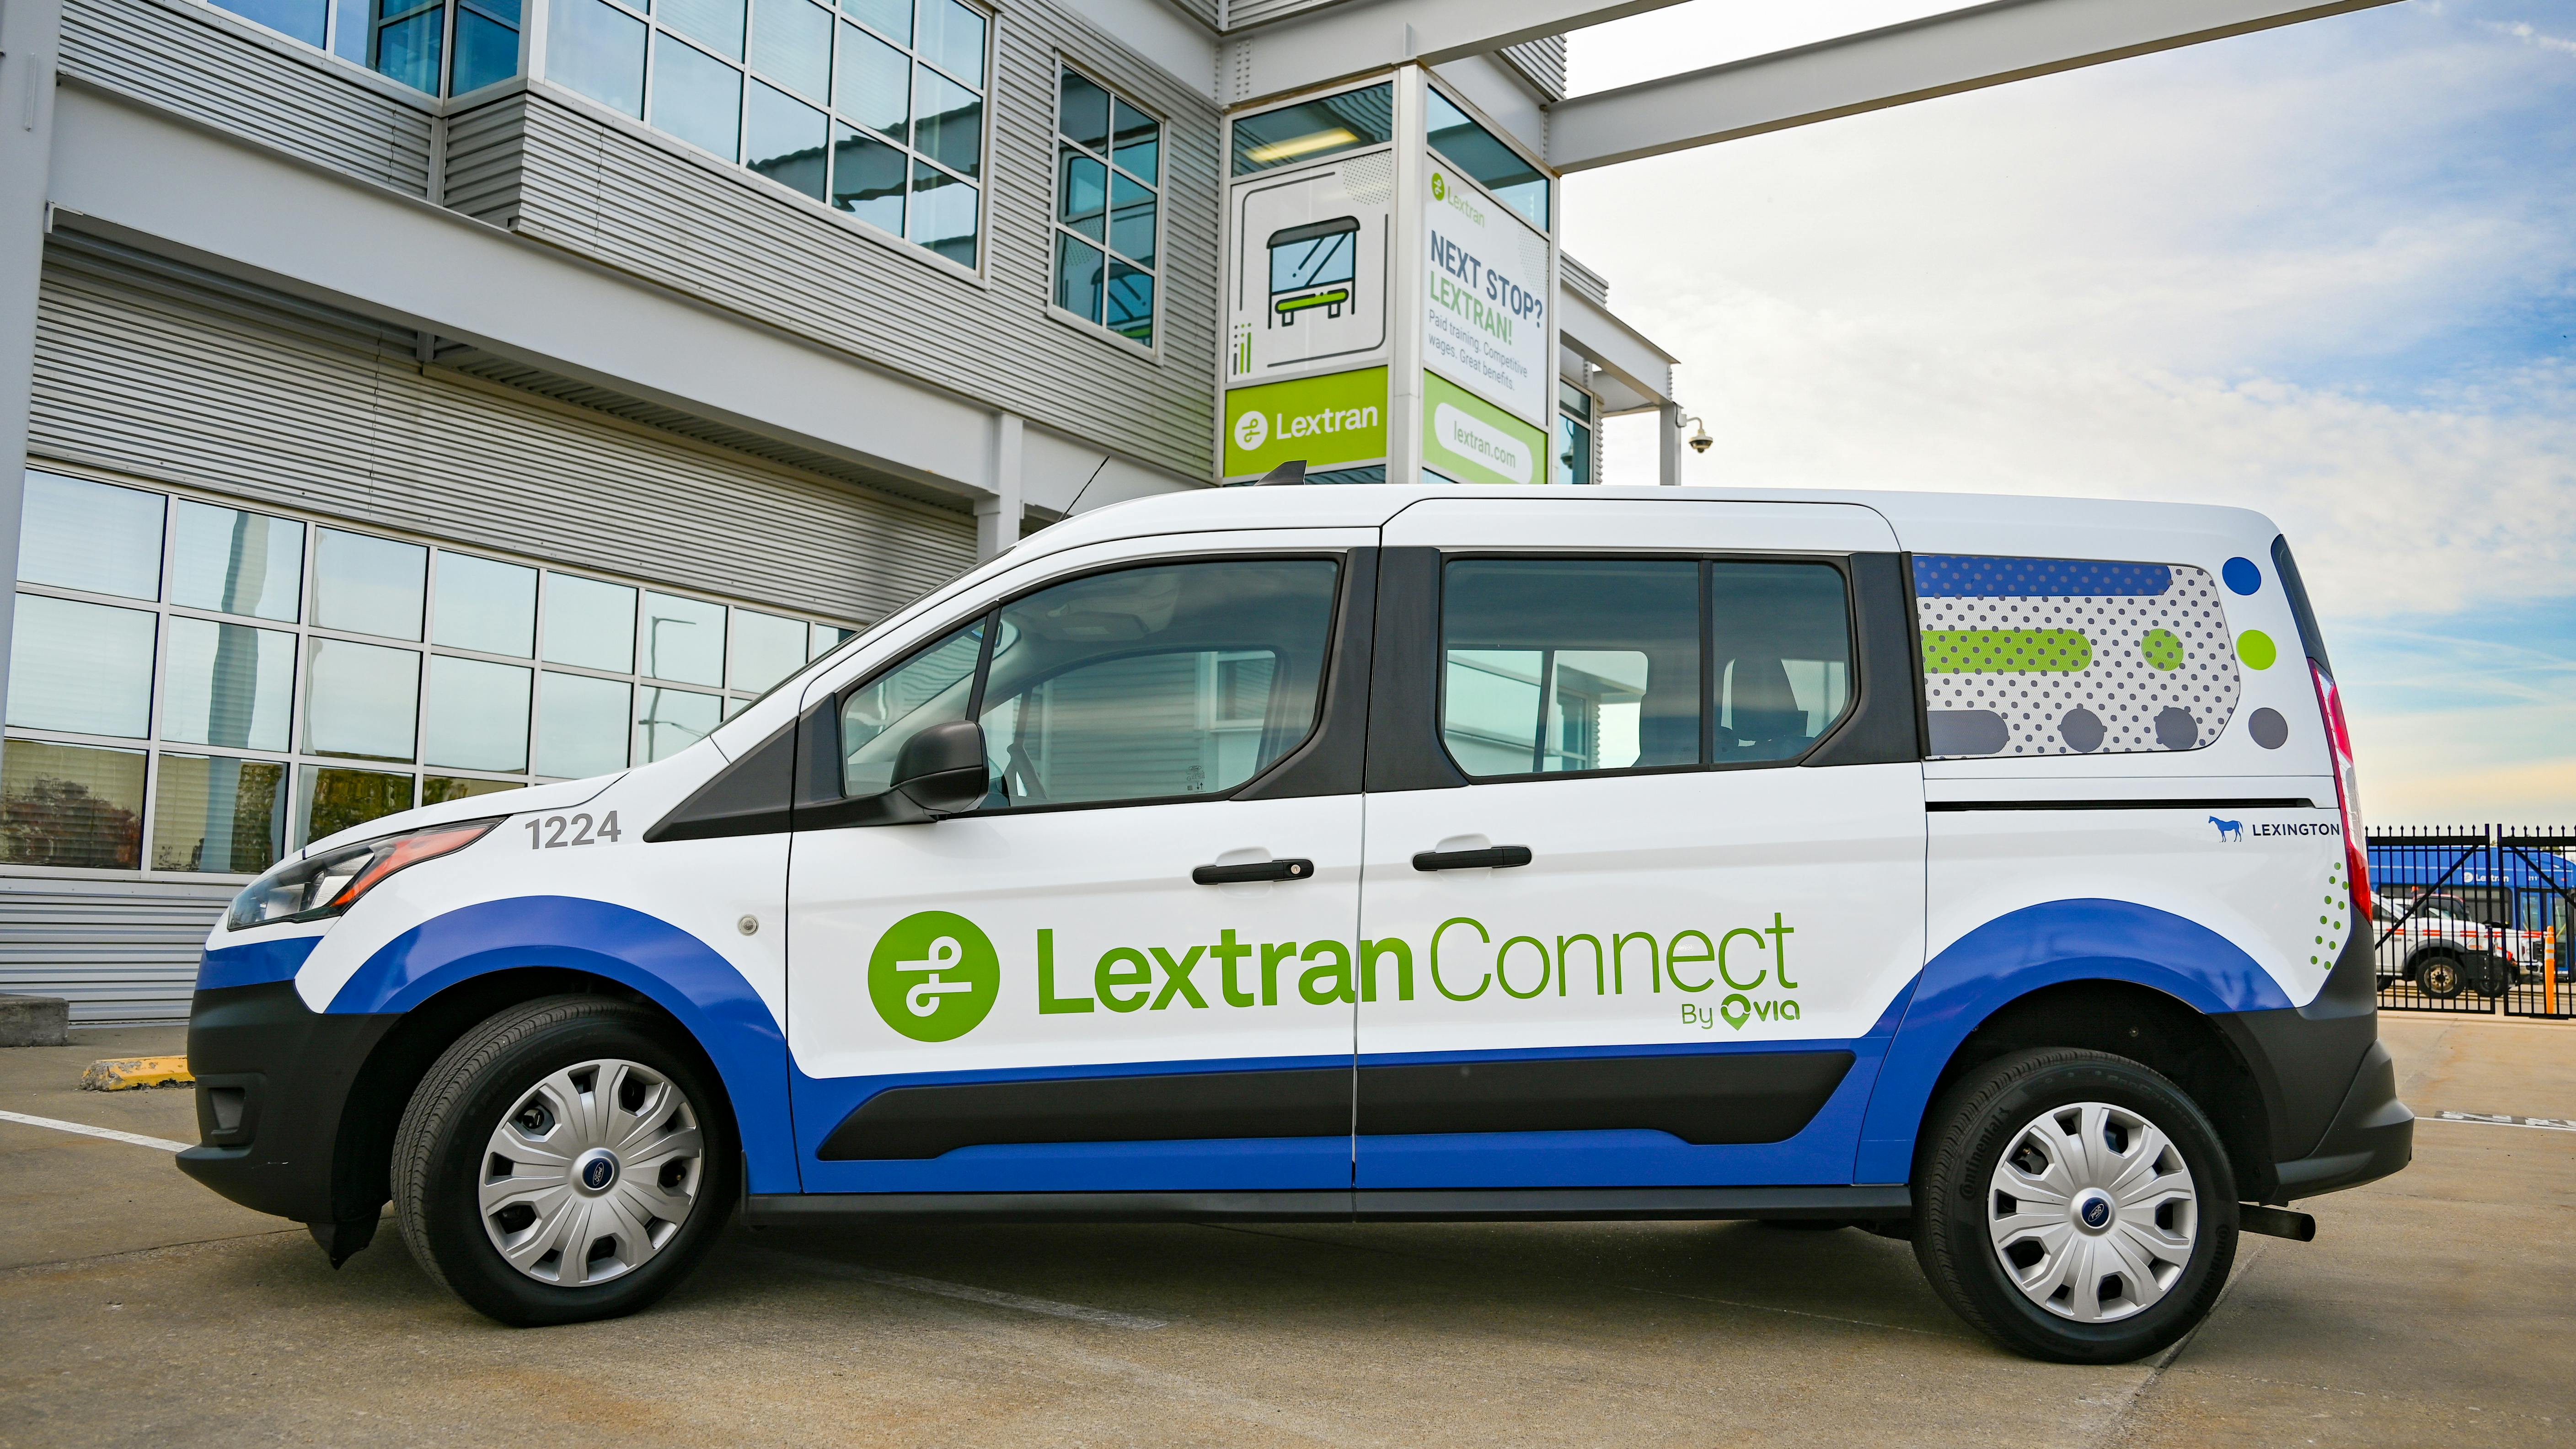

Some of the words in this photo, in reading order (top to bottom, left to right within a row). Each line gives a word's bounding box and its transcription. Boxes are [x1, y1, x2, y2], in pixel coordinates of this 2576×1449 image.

[1447, 186, 1485, 228] Lextran
[1430, 229, 1481, 289] NEXT
[1486, 269, 1542, 328] STOP?
[1430, 270, 1512, 345] LEXTRAN!
[1428, 333, 1457, 359] wages.
[1460, 348, 1481, 373] Great
[1483, 360, 1515, 391] benefits.
[1429, 309, 1447, 332] Paid
[1449, 322, 1481, 353] training.
[1483, 342, 1528, 378] Competitive
[1276, 406, 1378, 440] Lextran
[1453, 420, 1516, 469] lextran.com
[525, 810, 621, 850] 1224
[2252, 823, 2340, 836] LEXINGTON
[2475, 873, 2510, 882] Letrn
[1037, 928, 1414, 1015] Lextran
[1430, 912, 1798, 1002] Connect
[1682, 1004, 1714, 1030] By
[1959, 1114, 2004, 1201] Continental
